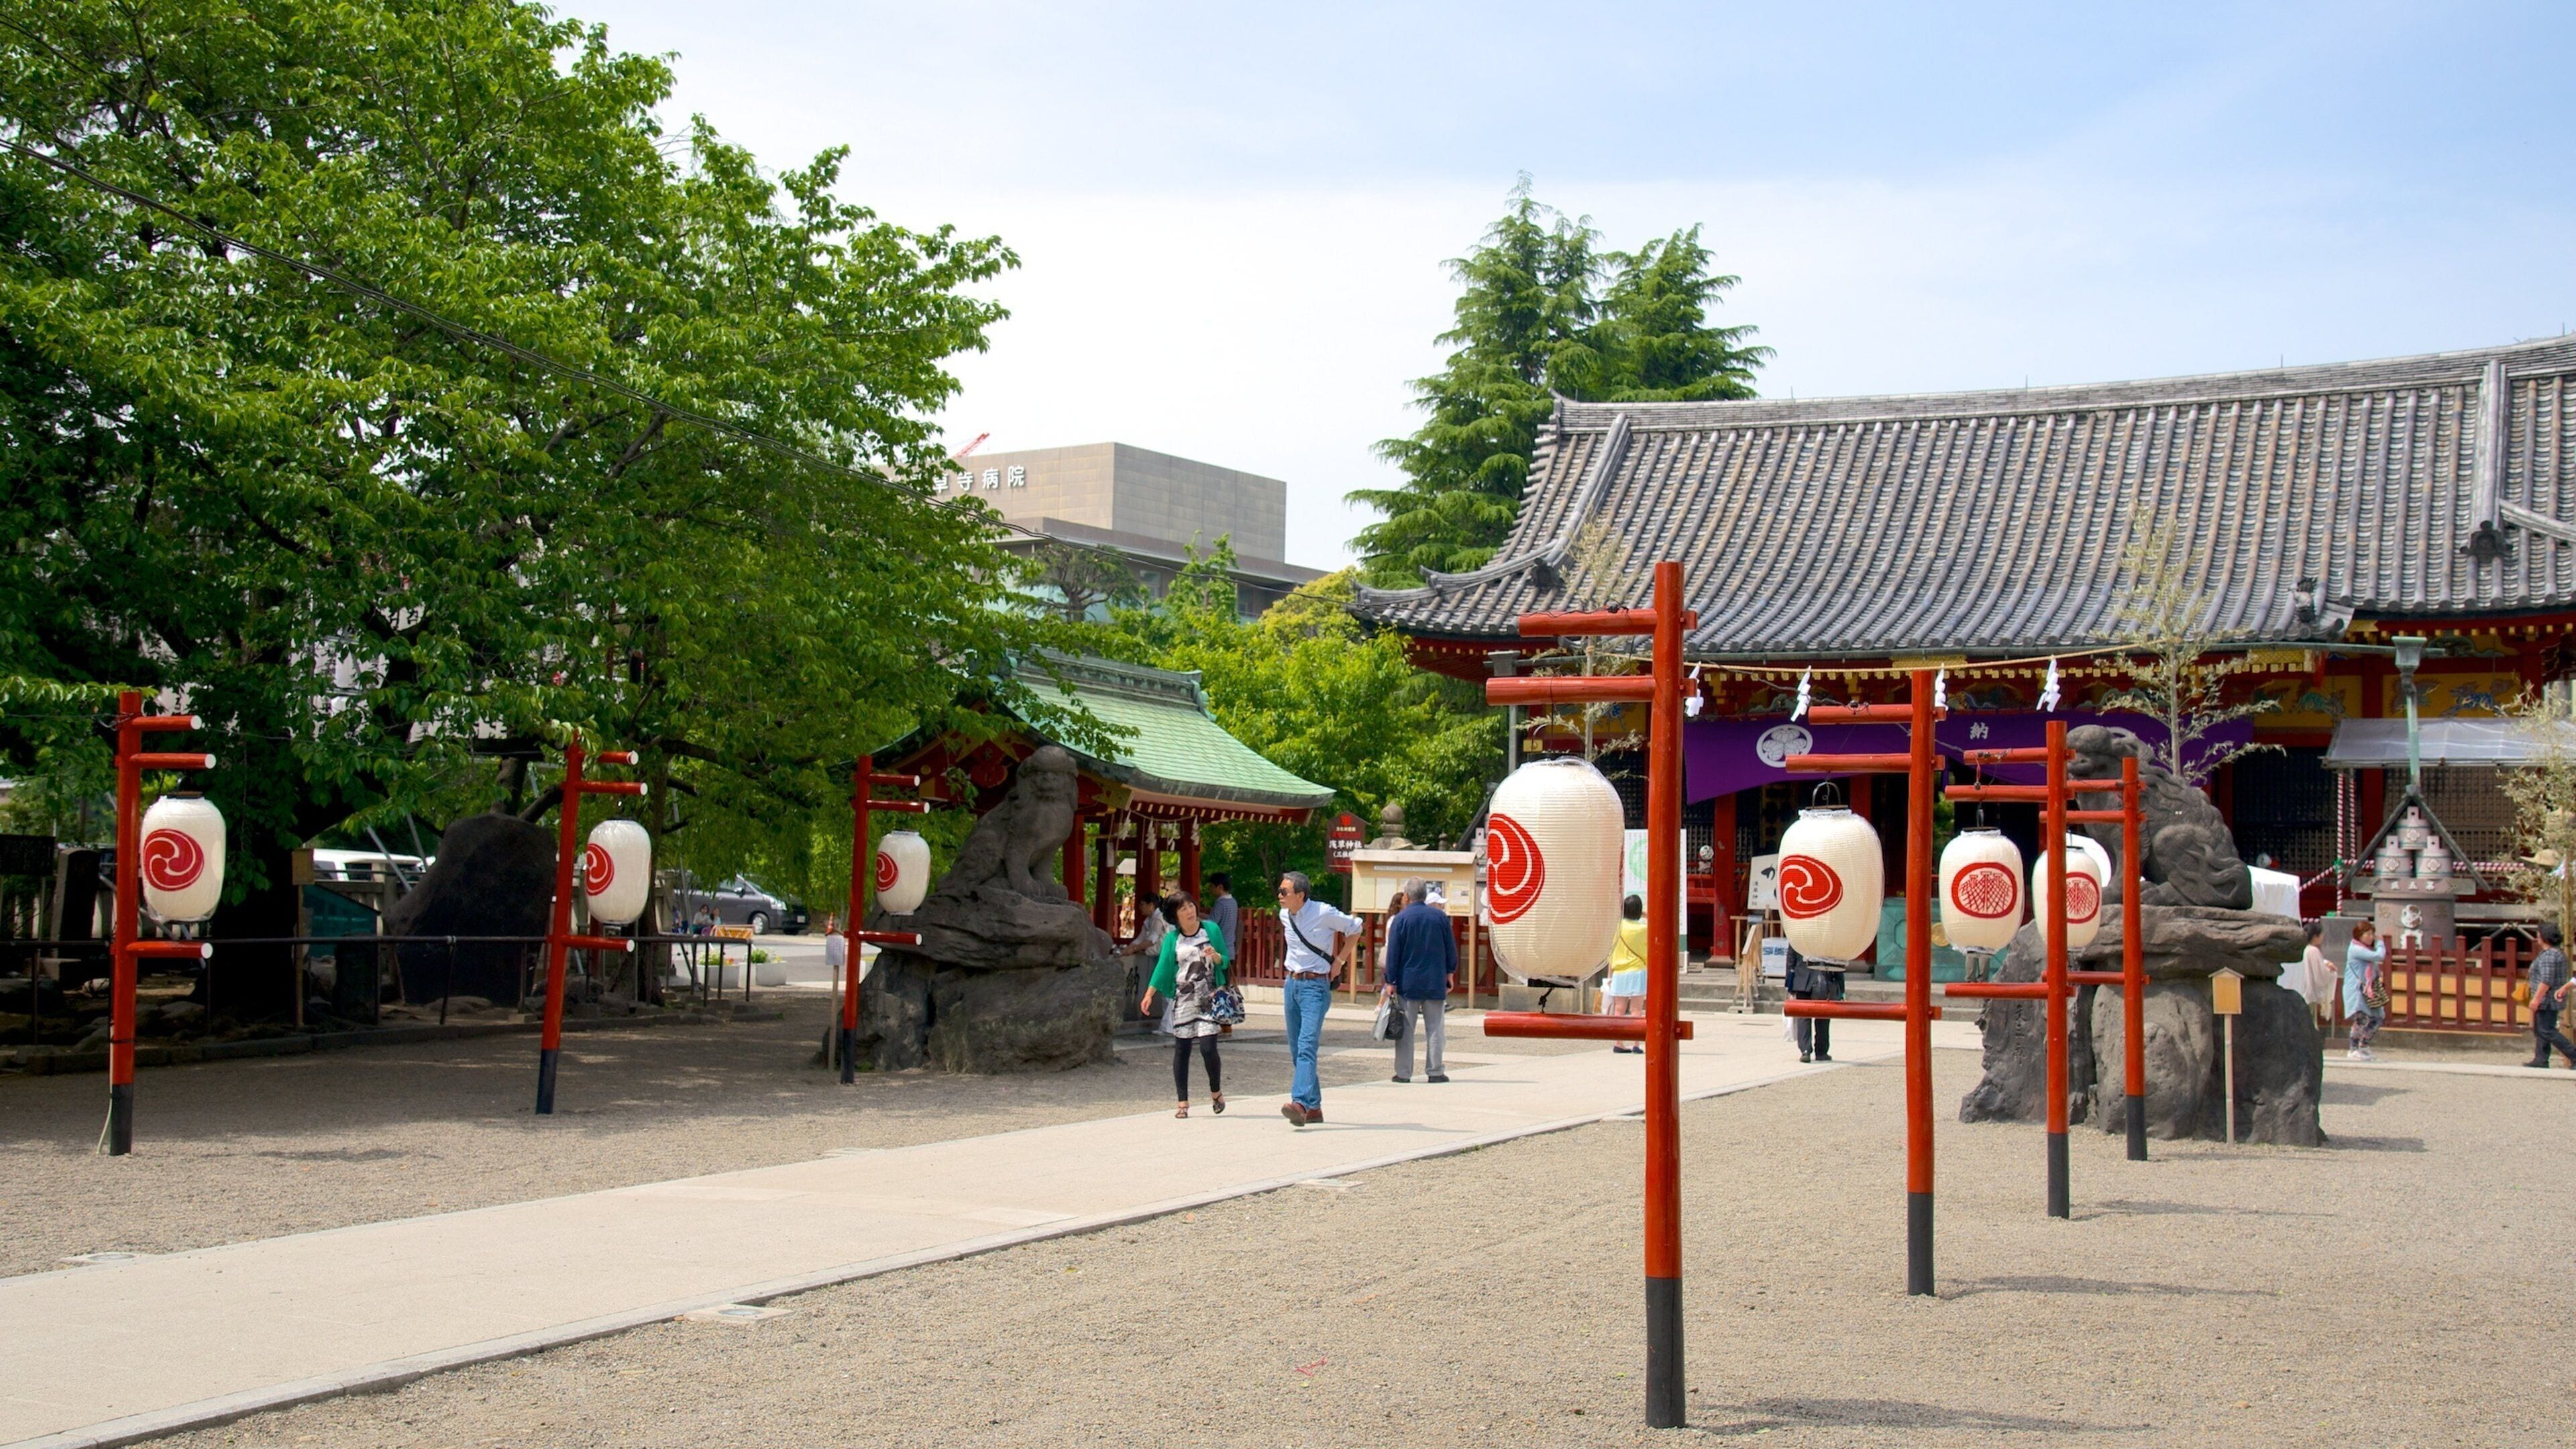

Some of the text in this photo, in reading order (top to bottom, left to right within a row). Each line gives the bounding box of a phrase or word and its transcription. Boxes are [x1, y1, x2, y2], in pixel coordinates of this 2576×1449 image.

[910, 465, 1026, 494] 草寺病院
[1970, 722, 1990, 740] 納
[1329, 840, 1362, 849] 浅草神社
